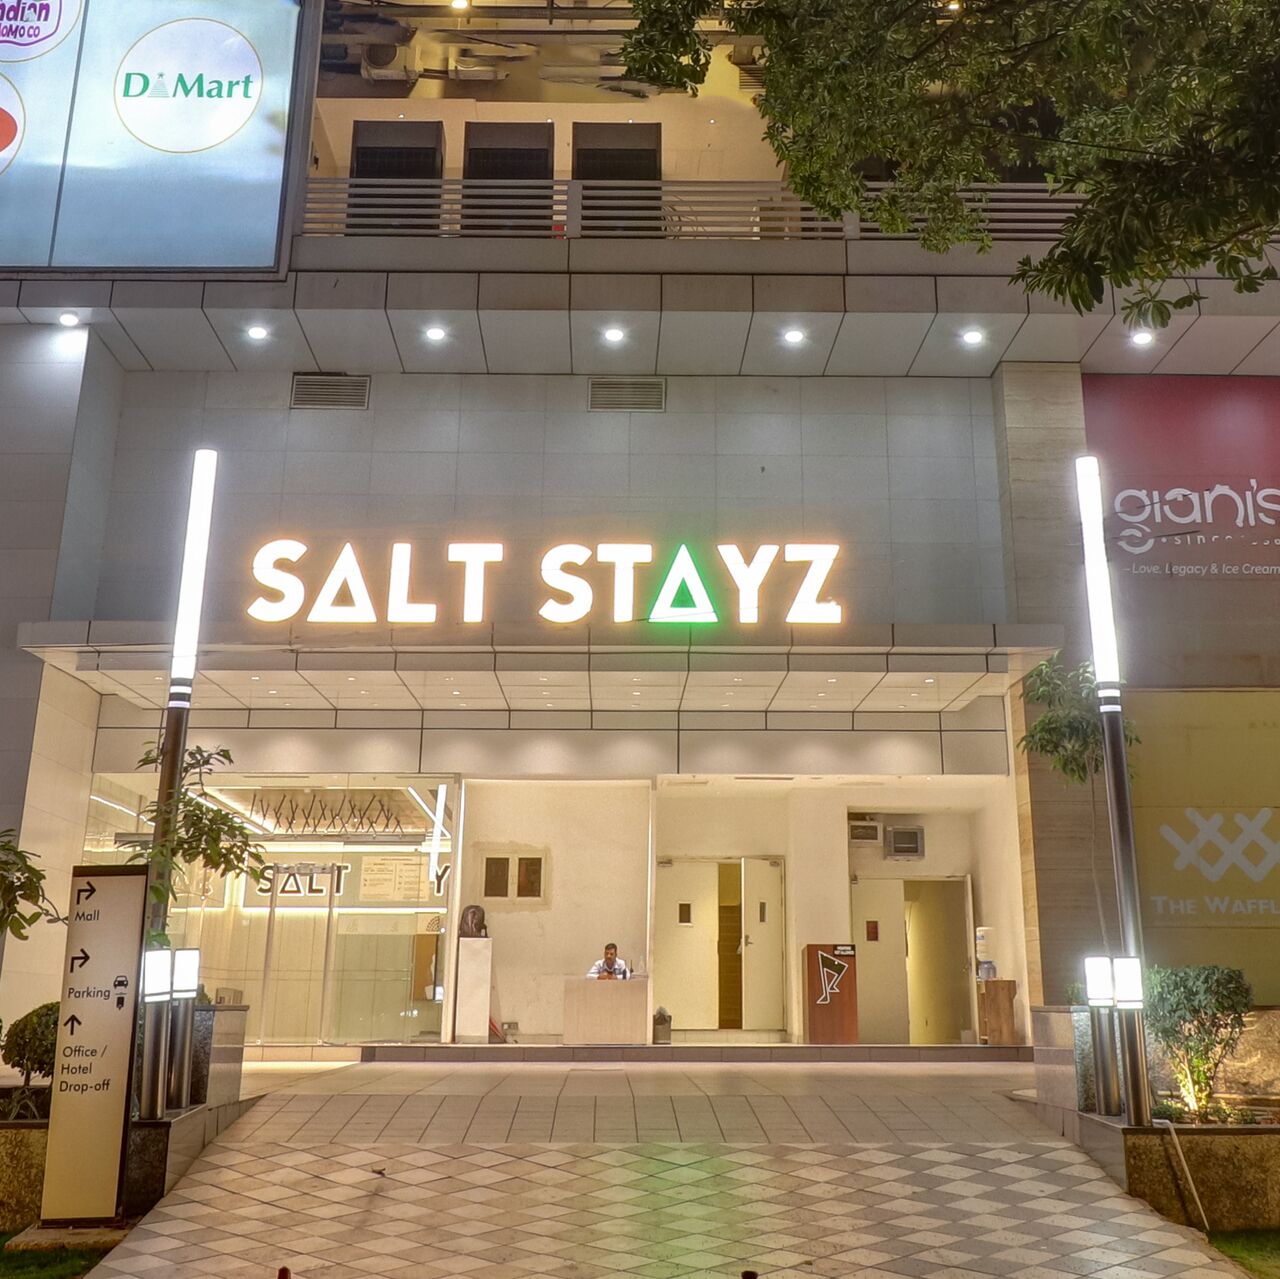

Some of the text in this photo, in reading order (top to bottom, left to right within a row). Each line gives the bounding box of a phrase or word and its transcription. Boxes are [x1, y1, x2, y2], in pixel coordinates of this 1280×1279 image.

[1165, 563, 1211, 577] Legacy
[1211, 563, 1220, 575] &
[1222, 563, 1239, 575] Ice
[246, 539, 842, 625] SALT STAYZ
[257, 863, 351, 896] SALT
[1150, 895, 1197, 915] THE
[74, 909, 100, 922] Mall
[67, 987, 111, 1001] Parking
[62, 1045, 98, 1058] Office
[60, 1062, 93, 1076] Hotel
[58, 1079, 111, 1095] Drop-off
